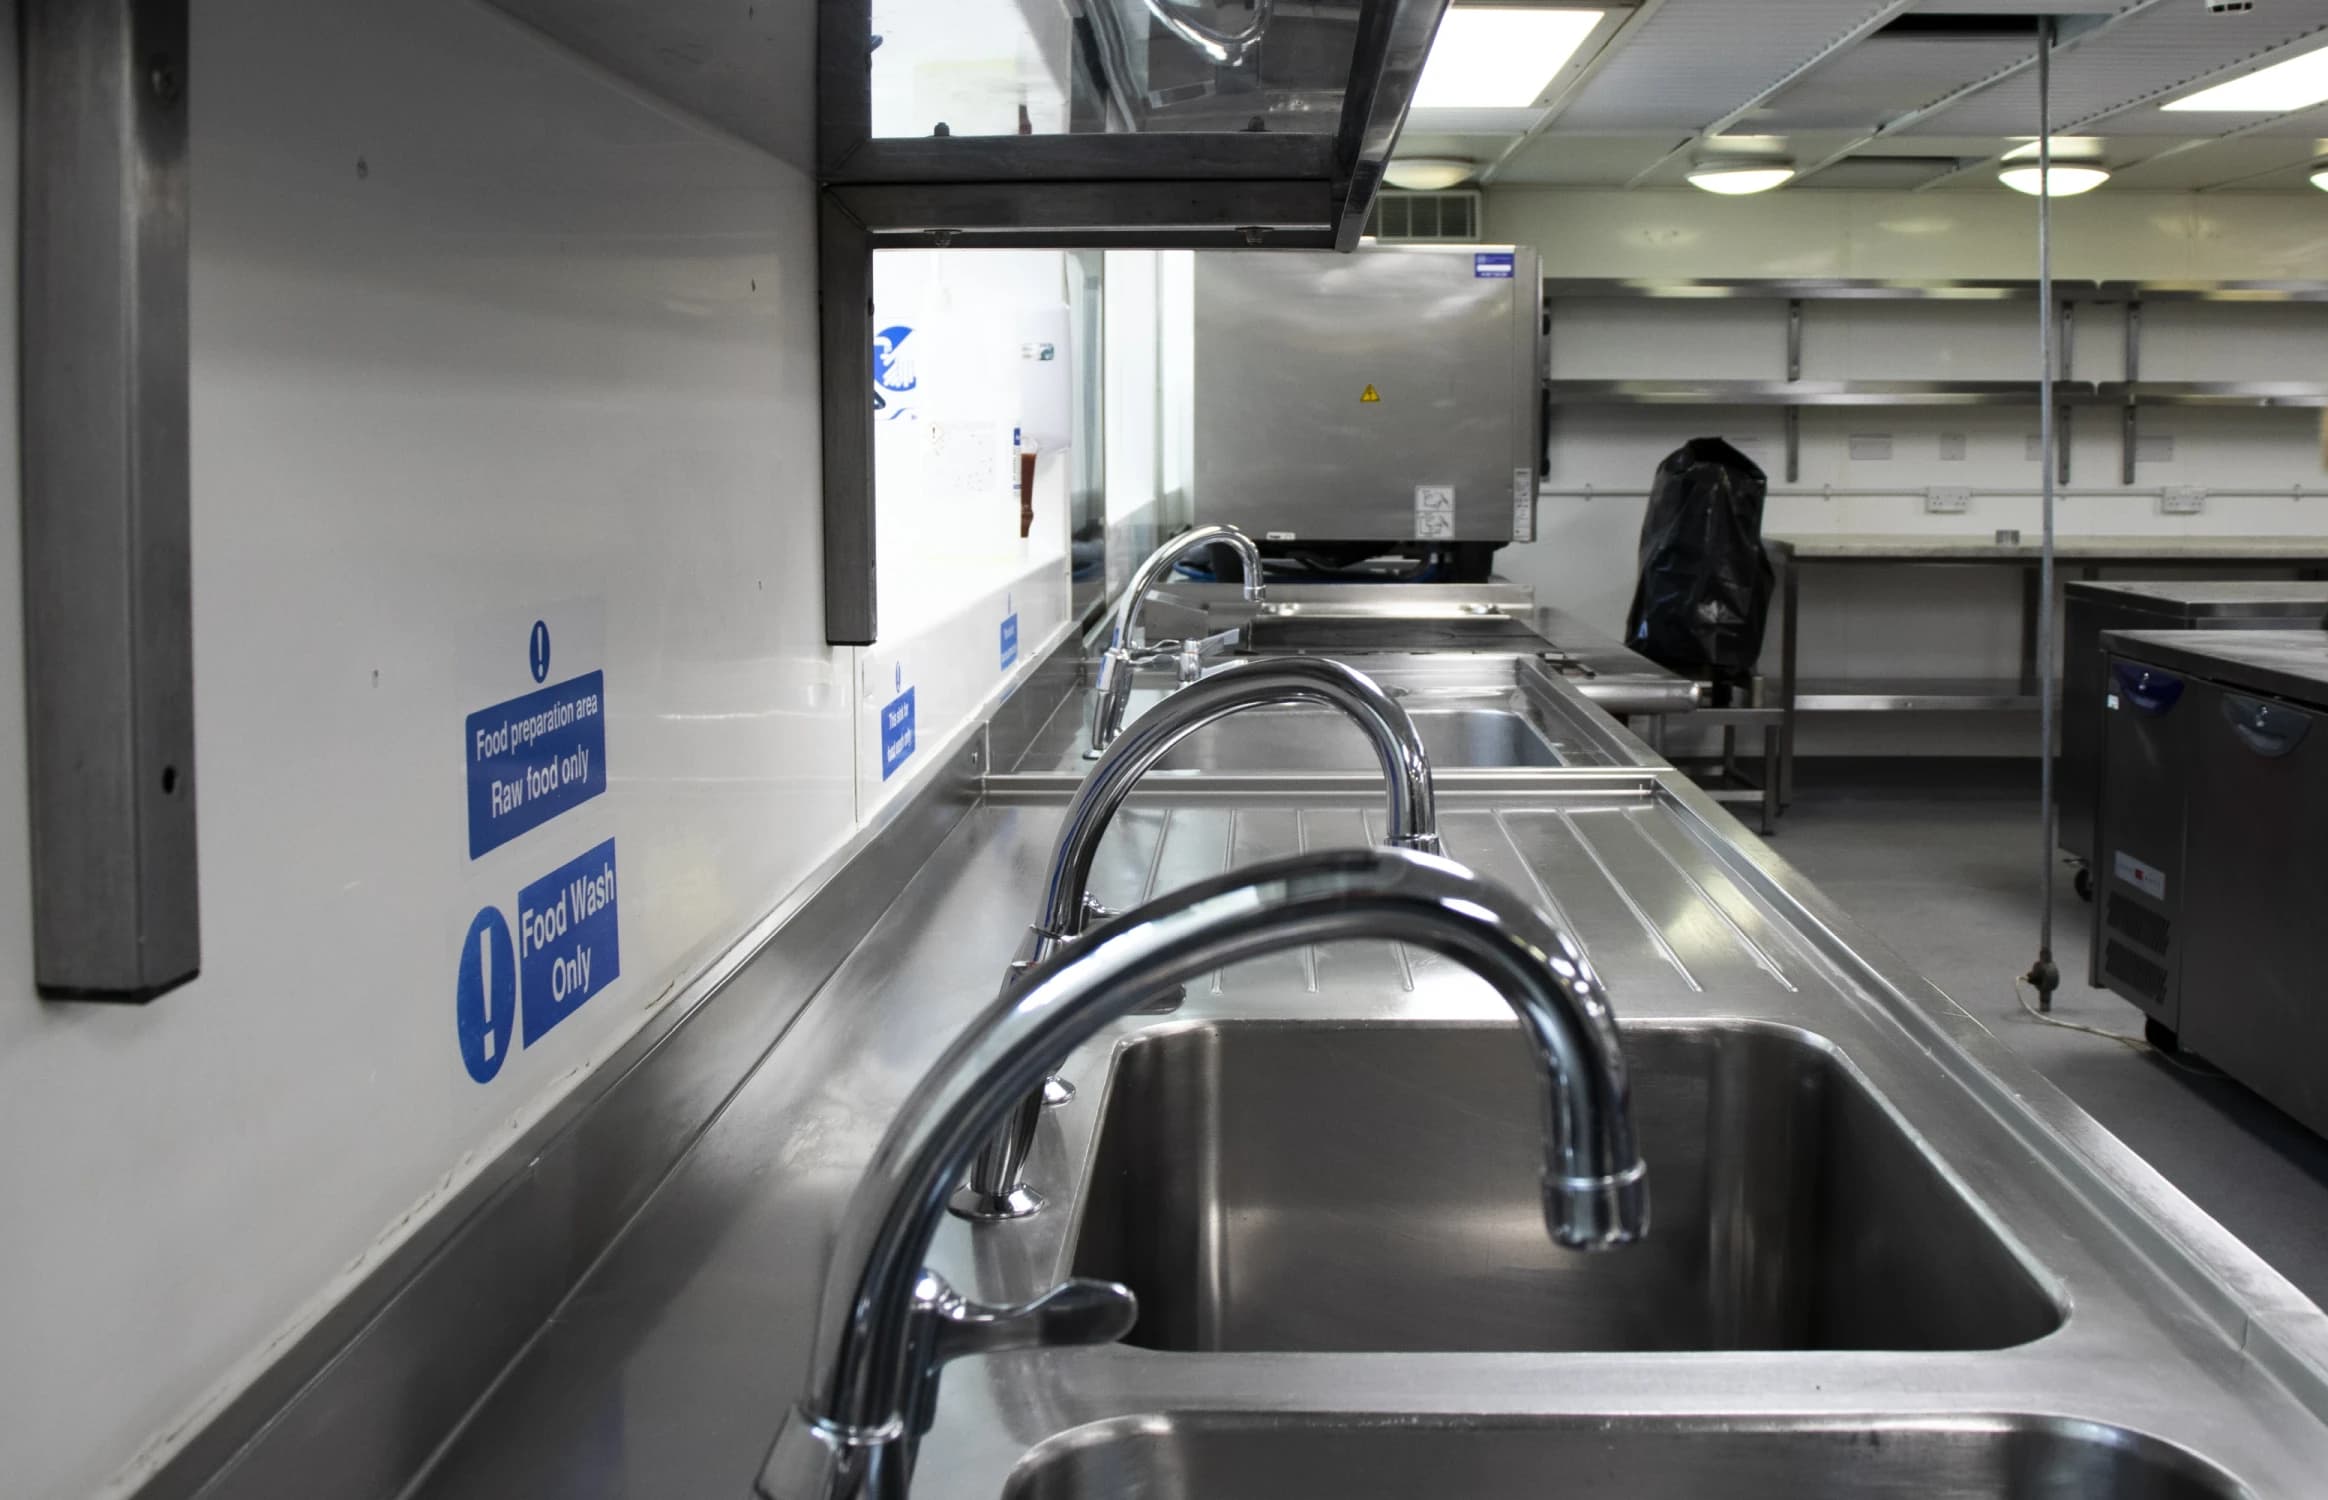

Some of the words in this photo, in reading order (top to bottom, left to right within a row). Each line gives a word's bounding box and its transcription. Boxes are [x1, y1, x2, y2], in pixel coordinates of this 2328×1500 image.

[476, 720, 508, 762] Food
[511, 701, 574, 755] preparation
[576, 694, 598, 720] area
[491, 780, 523, 819] Raw
[527, 755, 558, 800] food
[562, 744, 589, 784] only
[522, 889, 567, 959] Food
[571, 862, 614, 924] Wash
[552, 945, 591, 1003] Only
